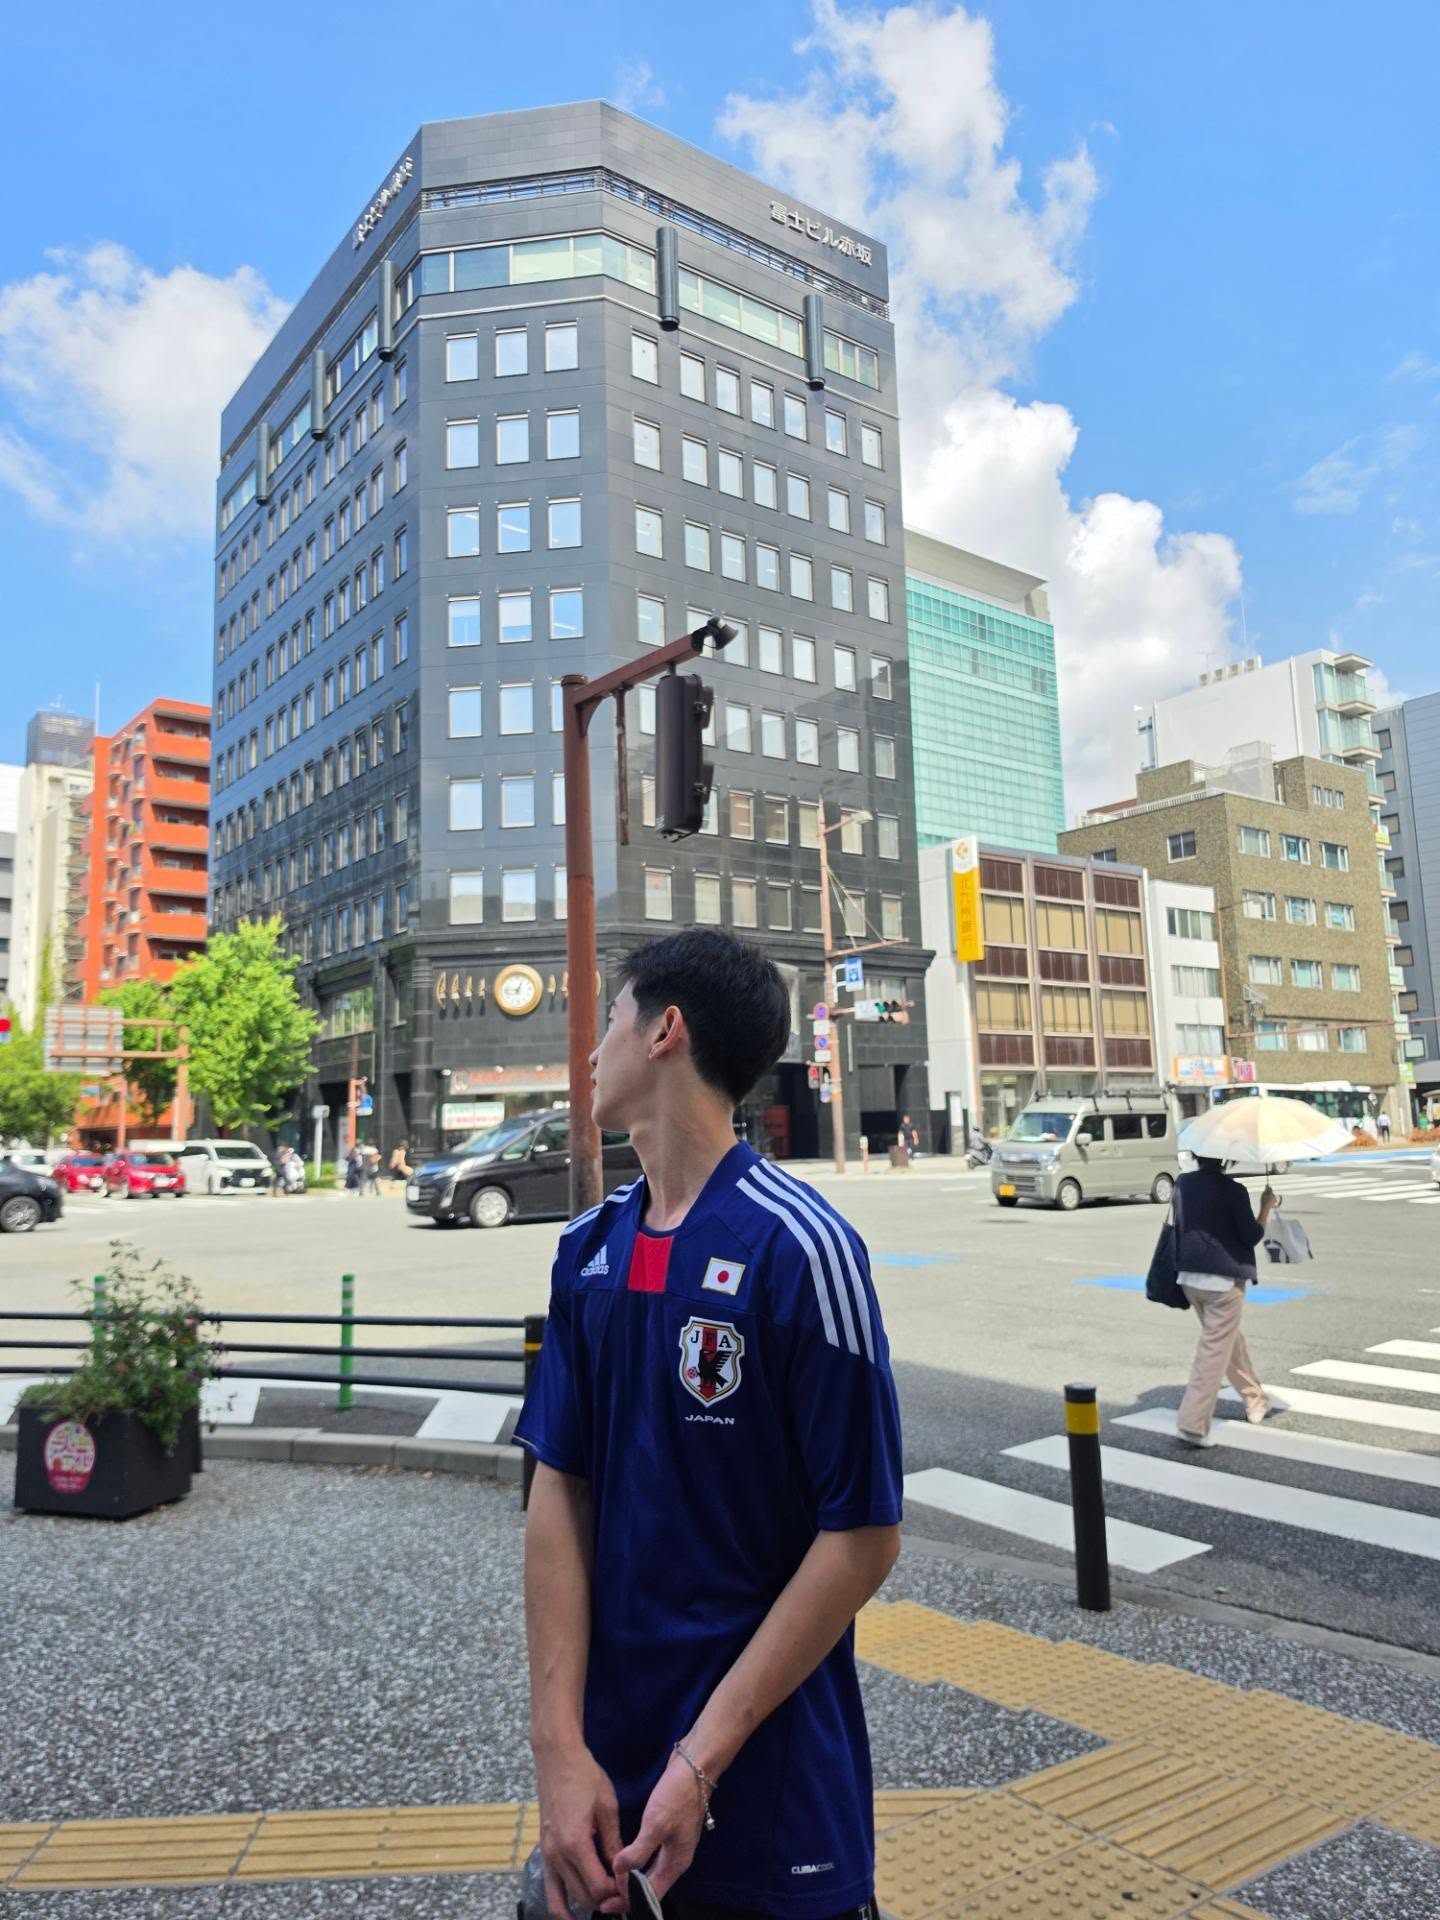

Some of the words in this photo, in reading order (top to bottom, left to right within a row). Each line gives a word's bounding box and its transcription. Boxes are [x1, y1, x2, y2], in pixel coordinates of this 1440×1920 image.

[770, 200, 872, 267] 富士ビル赤坂
[580, 1265, 609, 1276] adidas
[685, 1414, 735, 1425] JAPAN
